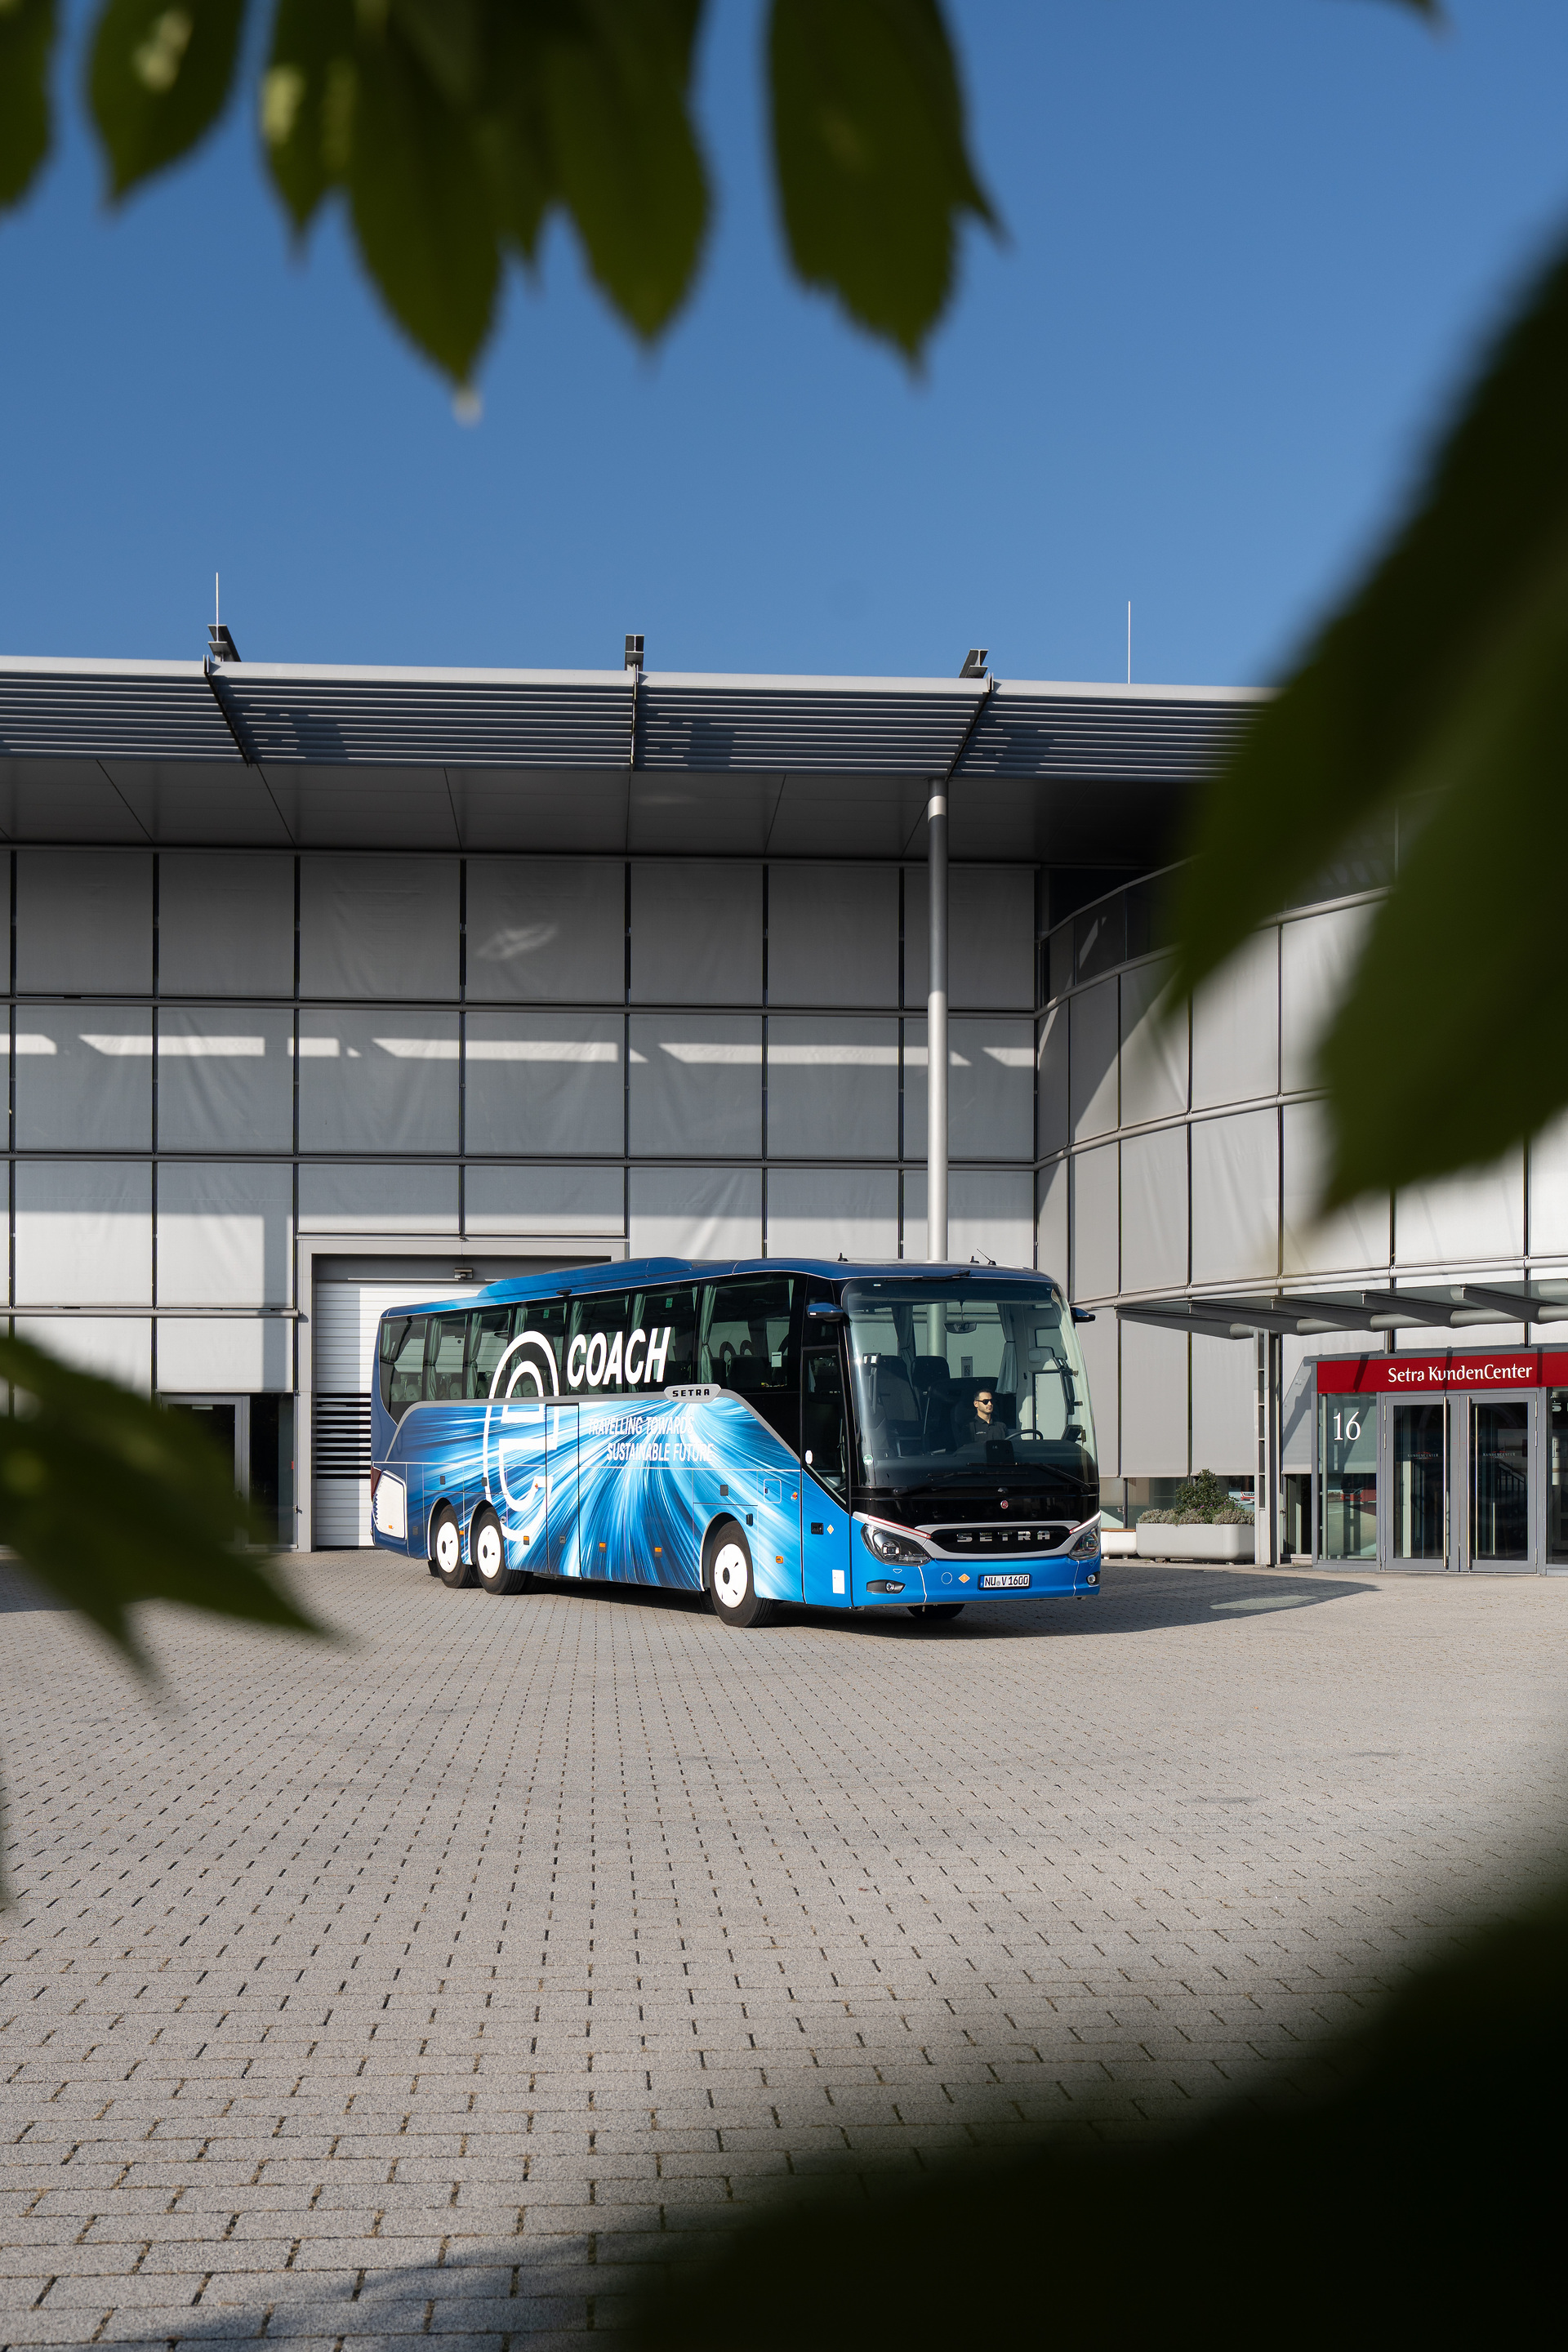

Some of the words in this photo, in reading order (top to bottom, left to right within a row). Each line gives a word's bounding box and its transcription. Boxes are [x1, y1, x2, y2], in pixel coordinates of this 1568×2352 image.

[567, 1326, 671, 1388] COACH
[1388, 1367, 1425, 1383] Setra
[1428, 1363, 1533, 1381] KundenCenter
[672, 1388, 710, 1397] SETRA
[588, 1416, 644, 1436] TRAVELLING
[646, 1415, 695, 1436] TOWARDS
[1333, 1410, 1361, 1441] 16
[607, 1442, 671, 1462] SUSTAINABLE
[673, 1442, 715, 1462] FUTURE
[956, 1530, 1050, 1543] SETRA
[984, 1576, 996, 1586] NU
[1008, 1575, 1028, 1586] 1600
